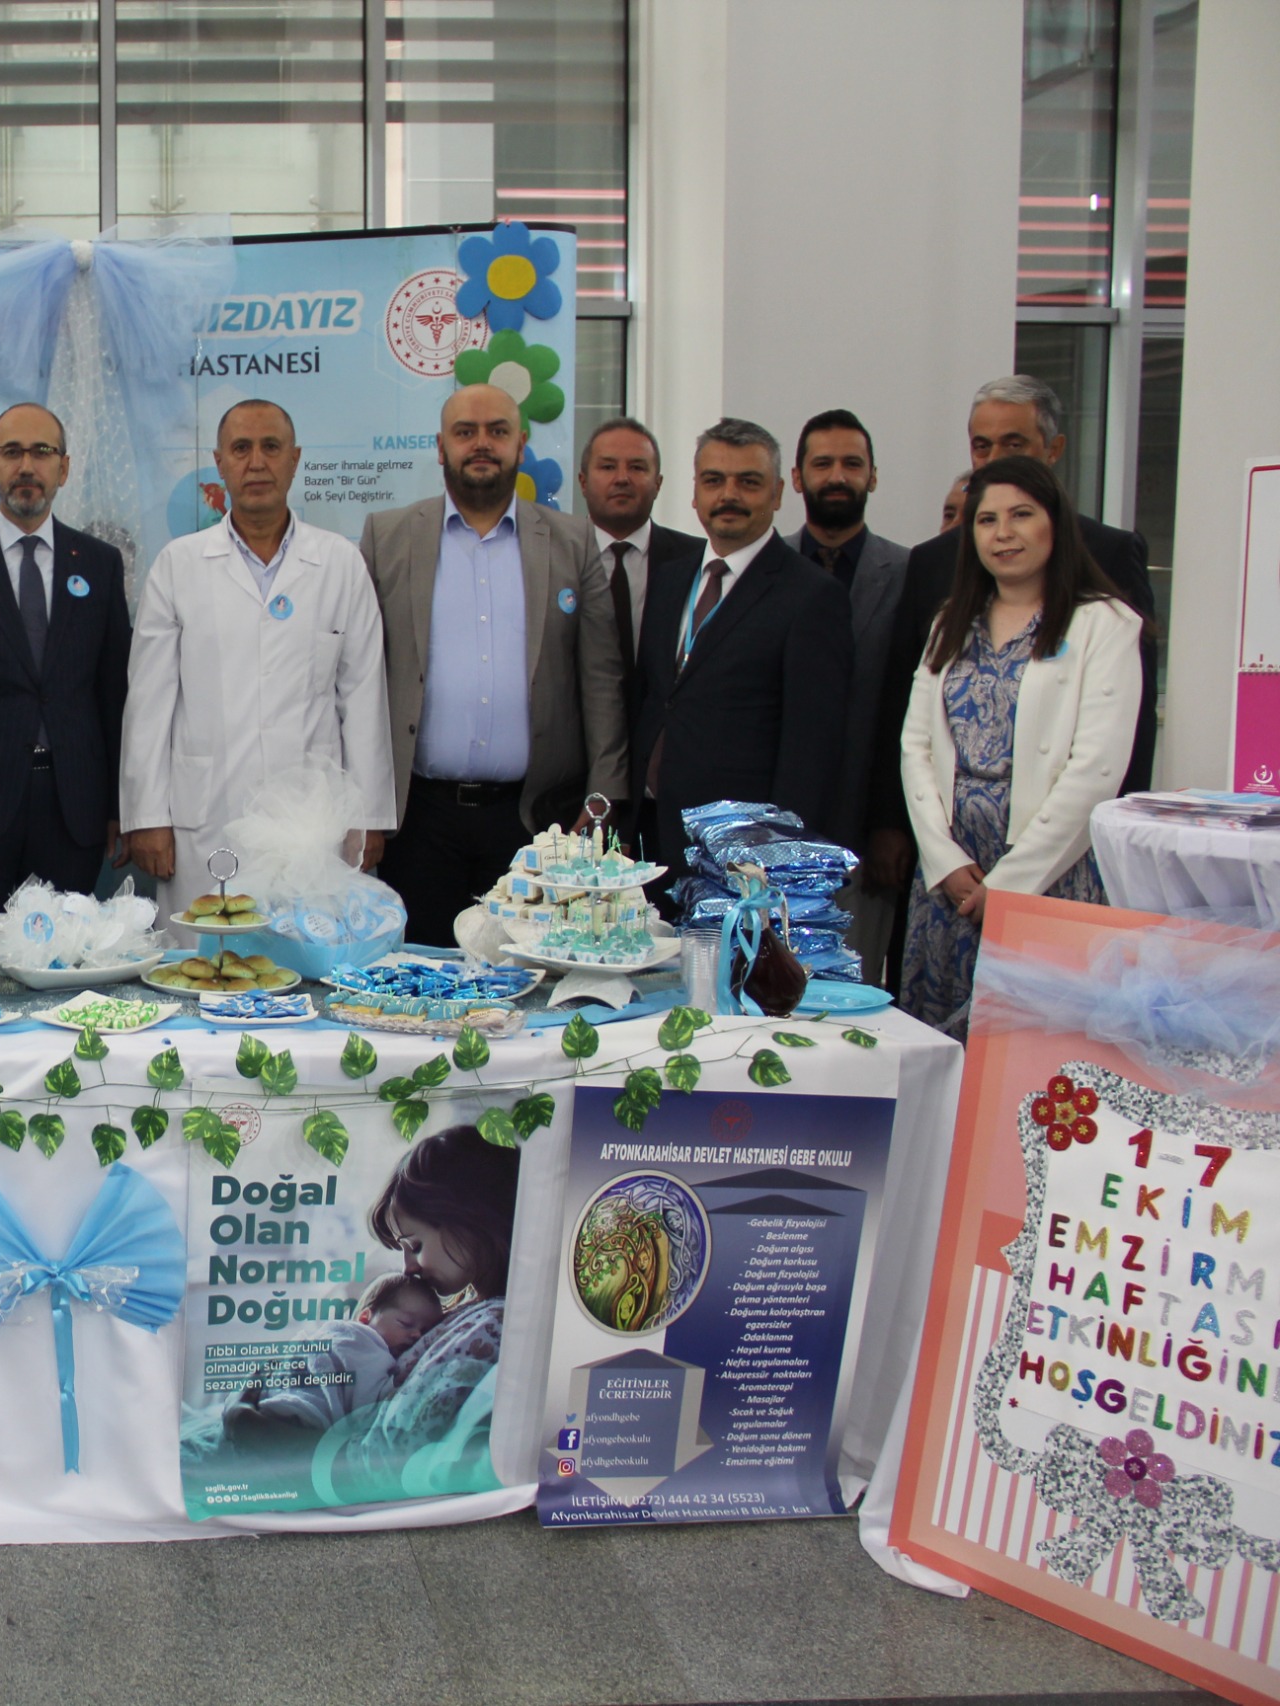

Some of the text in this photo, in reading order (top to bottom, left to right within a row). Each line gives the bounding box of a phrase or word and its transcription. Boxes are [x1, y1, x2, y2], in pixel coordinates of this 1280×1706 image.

[193, 297, 357, 333] IZDAYIZ
[373, 434, 437, 450] KANSER
[304, 459, 413, 473] Kanser ihmale gelmez
[304, 476, 334, 486] Bazen
[304, 491, 322, 503] Çok
[325, 491, 346, 503] Şeyi
[600, 1142, 852, 1167] AFYONKARAHİSAR DEVLET HASTANESİ GEBE OKULU
[211, 1174, 337, 1213] Doğal
[1100, 1173, 1252, 1244] EKİM
[209, 1213, 310, 1245] Olan
[784, 1219, 827, 1230] fizyolojisi
[766, 1232, 808, 1241] Beslenme
[757, 1244, 814, 1255] Doğum algısı
[749, 1257, 818, 1268] Doğum korkusu
[208, 1252, 365, 1285] Normal
[744, 1270, 819, 1280] Doğum fizyolojisi
[733, 1282, 827, 1293] Doğum ağrısıyla başa
[734, 1295, 810, 1305] çıkma yöntemleri
[207, 1290, 358, 1330] Doğum
[730, 1308, 825, 1318] Doğumu kolaylaştıran
[745, 1320, 792, 1330] egzersizler
[207, 1341, 330, 1358] Tıbbi olarak zorunlu
[737, 1345, 791, 1355] Hayal kurma
[1026, 1301, 1280, 1404] ETKİNLİĞİN
[206, 1358, 306, 1375] olmadığı sürece
[726, 1357, 809, 1368] Nefes uygulamaları
[720, 1370, 812, 1380] Akupressür noktaları
[205, 1372, 354, 1391] sezaryen doğal değildir.
[606, 1378, 670, 1389] EĞİTİMLER
[738, 1382, 794, 1392] Aromaterapi
[599, 1388, 672, 1399] ÜCRETSİZDİR
[746, 1395, 786, 1404] Masajlar
[768, 1407, 794, 1417] Soğuk
[585, 1412, 641, 1424] afyondhgebe
[733, 1420, 787, 1430] uygulamalar
[583, 1434, 651, 1446] afyongebeokulu
[727, 1432, 811, 1442] Doğum sonu dönem
[731, 1444, 806, 1455] Yenidoğan bakımı
[726, 1456, 794, 1467] Emzirme eğitimi
[205, 1484, 249, 1493] saglik.gov.tr
[571, 1494, 623, 1508] İLETİŞİM
[668, 1494, 690, 1504] 444
[693, 1494, 708, 1504] 42
[710, 1493, 725, 1503] 34
[728, 1492, 765, 1505] (5523)
[551, 1505, 812, 1522] Afyonkarahisar Devlet Hastanesi B Blok 2. kat
